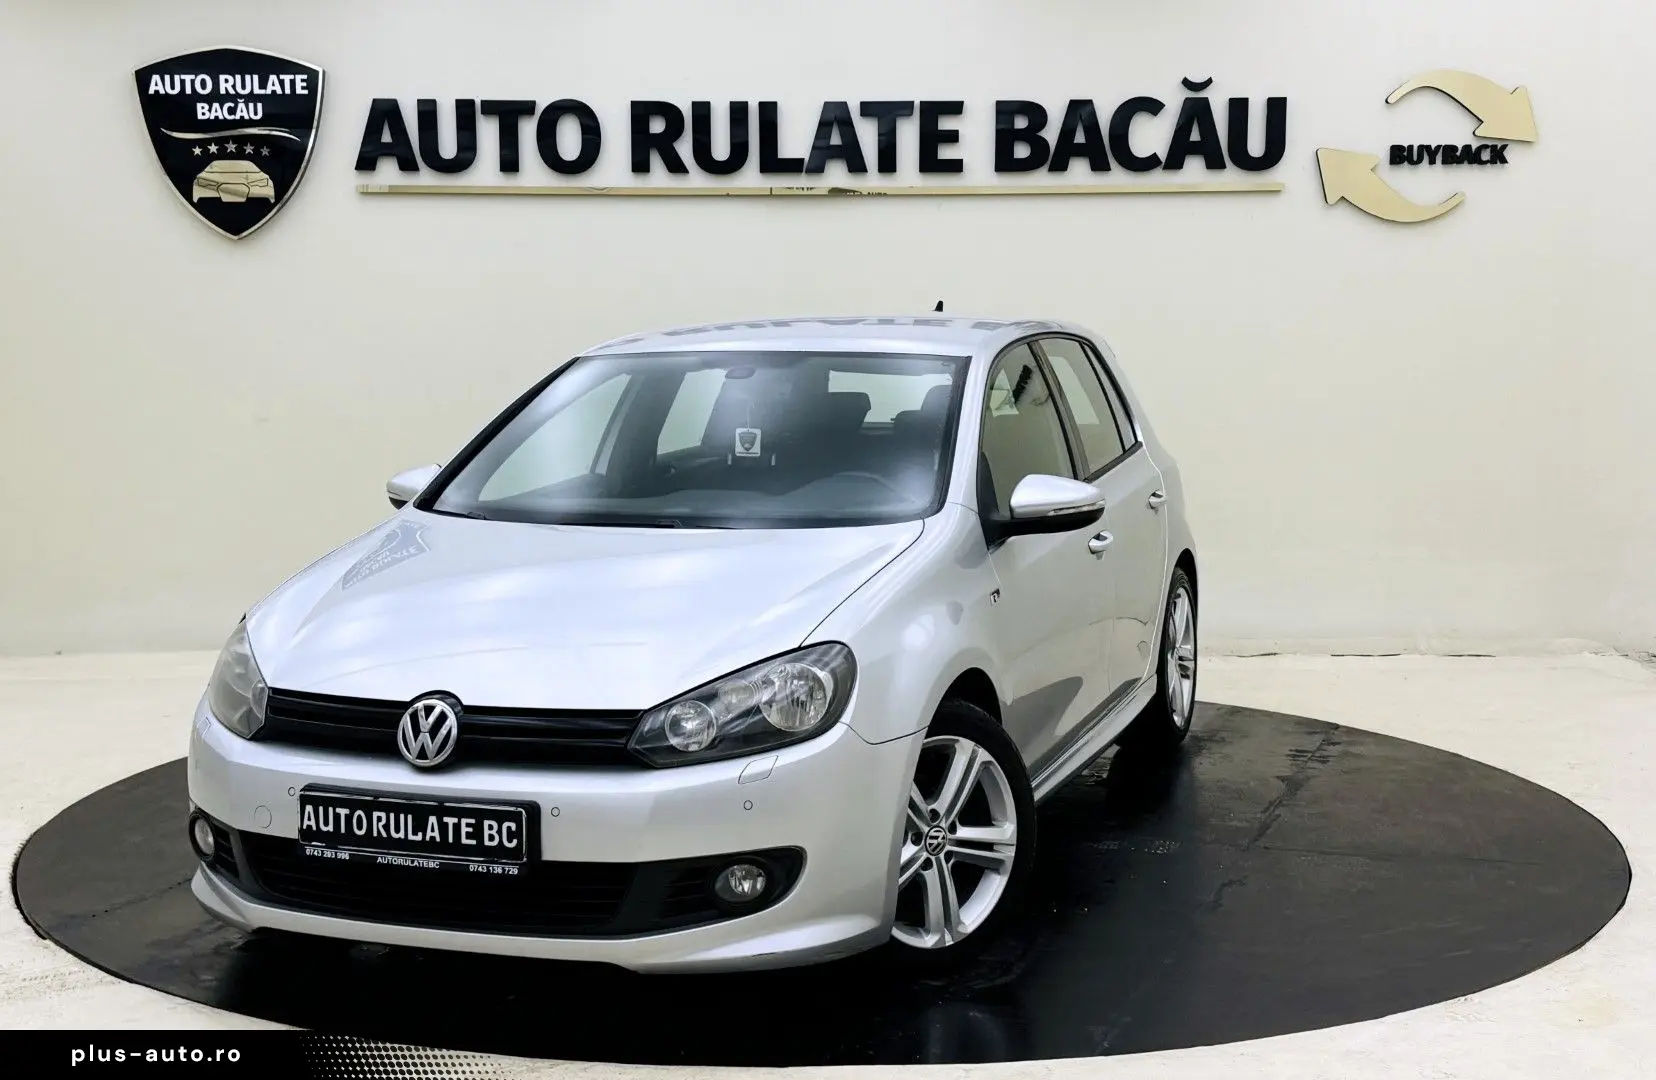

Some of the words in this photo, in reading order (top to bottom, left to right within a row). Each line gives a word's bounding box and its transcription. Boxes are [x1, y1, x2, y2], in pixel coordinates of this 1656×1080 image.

[148, 74, 213, 95] AUTO
[219, 74, 309, 95] RULATE
[196, 98, 263, 120] BACĂU
[355, 98, 602, 175] AUTO
[630, 100, 965, 175] RULATE
[994, 76, 1288, 172] BACĂU
[1389, 143, 1508, 166] BUYBACK
[302, 804, 368, 836] AUTO
[372, 811, 477, 845] RULATE
[483, 819, 518, 848] BC
[305, 848, 322, 857] 0743
[376, 856, 440, 868] AUTORULATEBC
[469, 864, 487, 873] 0743
[503, 867, 518, 875] 729
